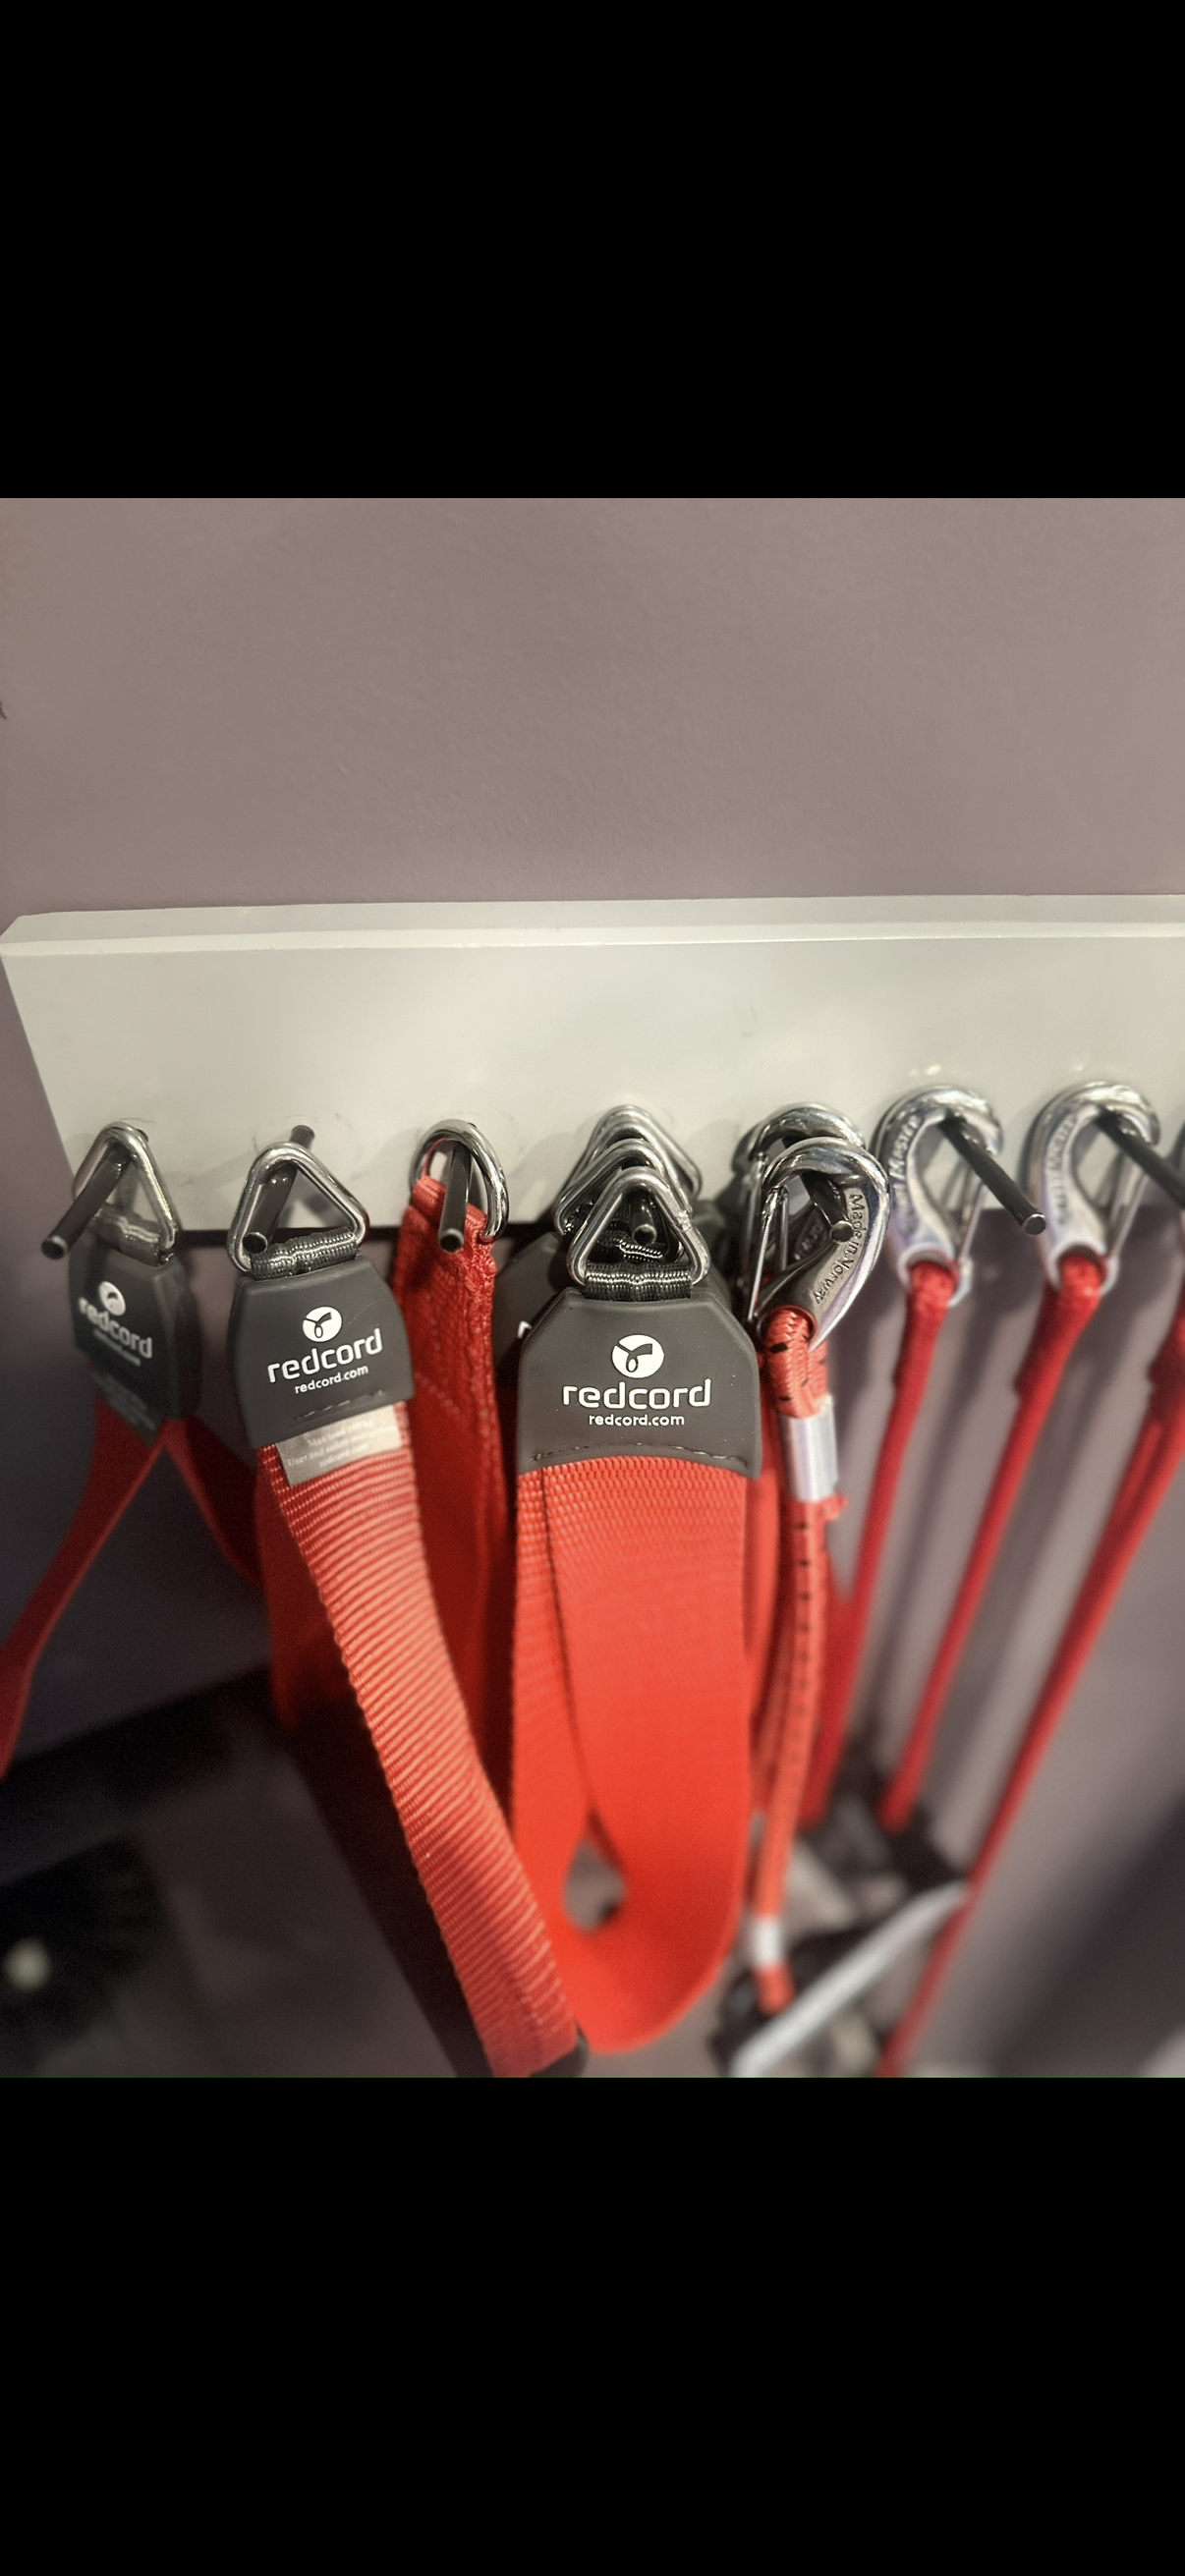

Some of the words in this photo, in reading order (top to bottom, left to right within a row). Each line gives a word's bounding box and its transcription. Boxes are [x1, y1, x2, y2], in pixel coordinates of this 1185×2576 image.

[848, 1193, 867, 1240] Made
[812, 1256, 855, 1305] Norway
[78, 1296, 153, 1360] redcord
[267, 1327, 383, 1383] redcord
[295, 1365, 369, 1394] redcord.com
[562, 1377, 711, 1410] redcord
[589, 1413, 686, 1427] redcord.com
